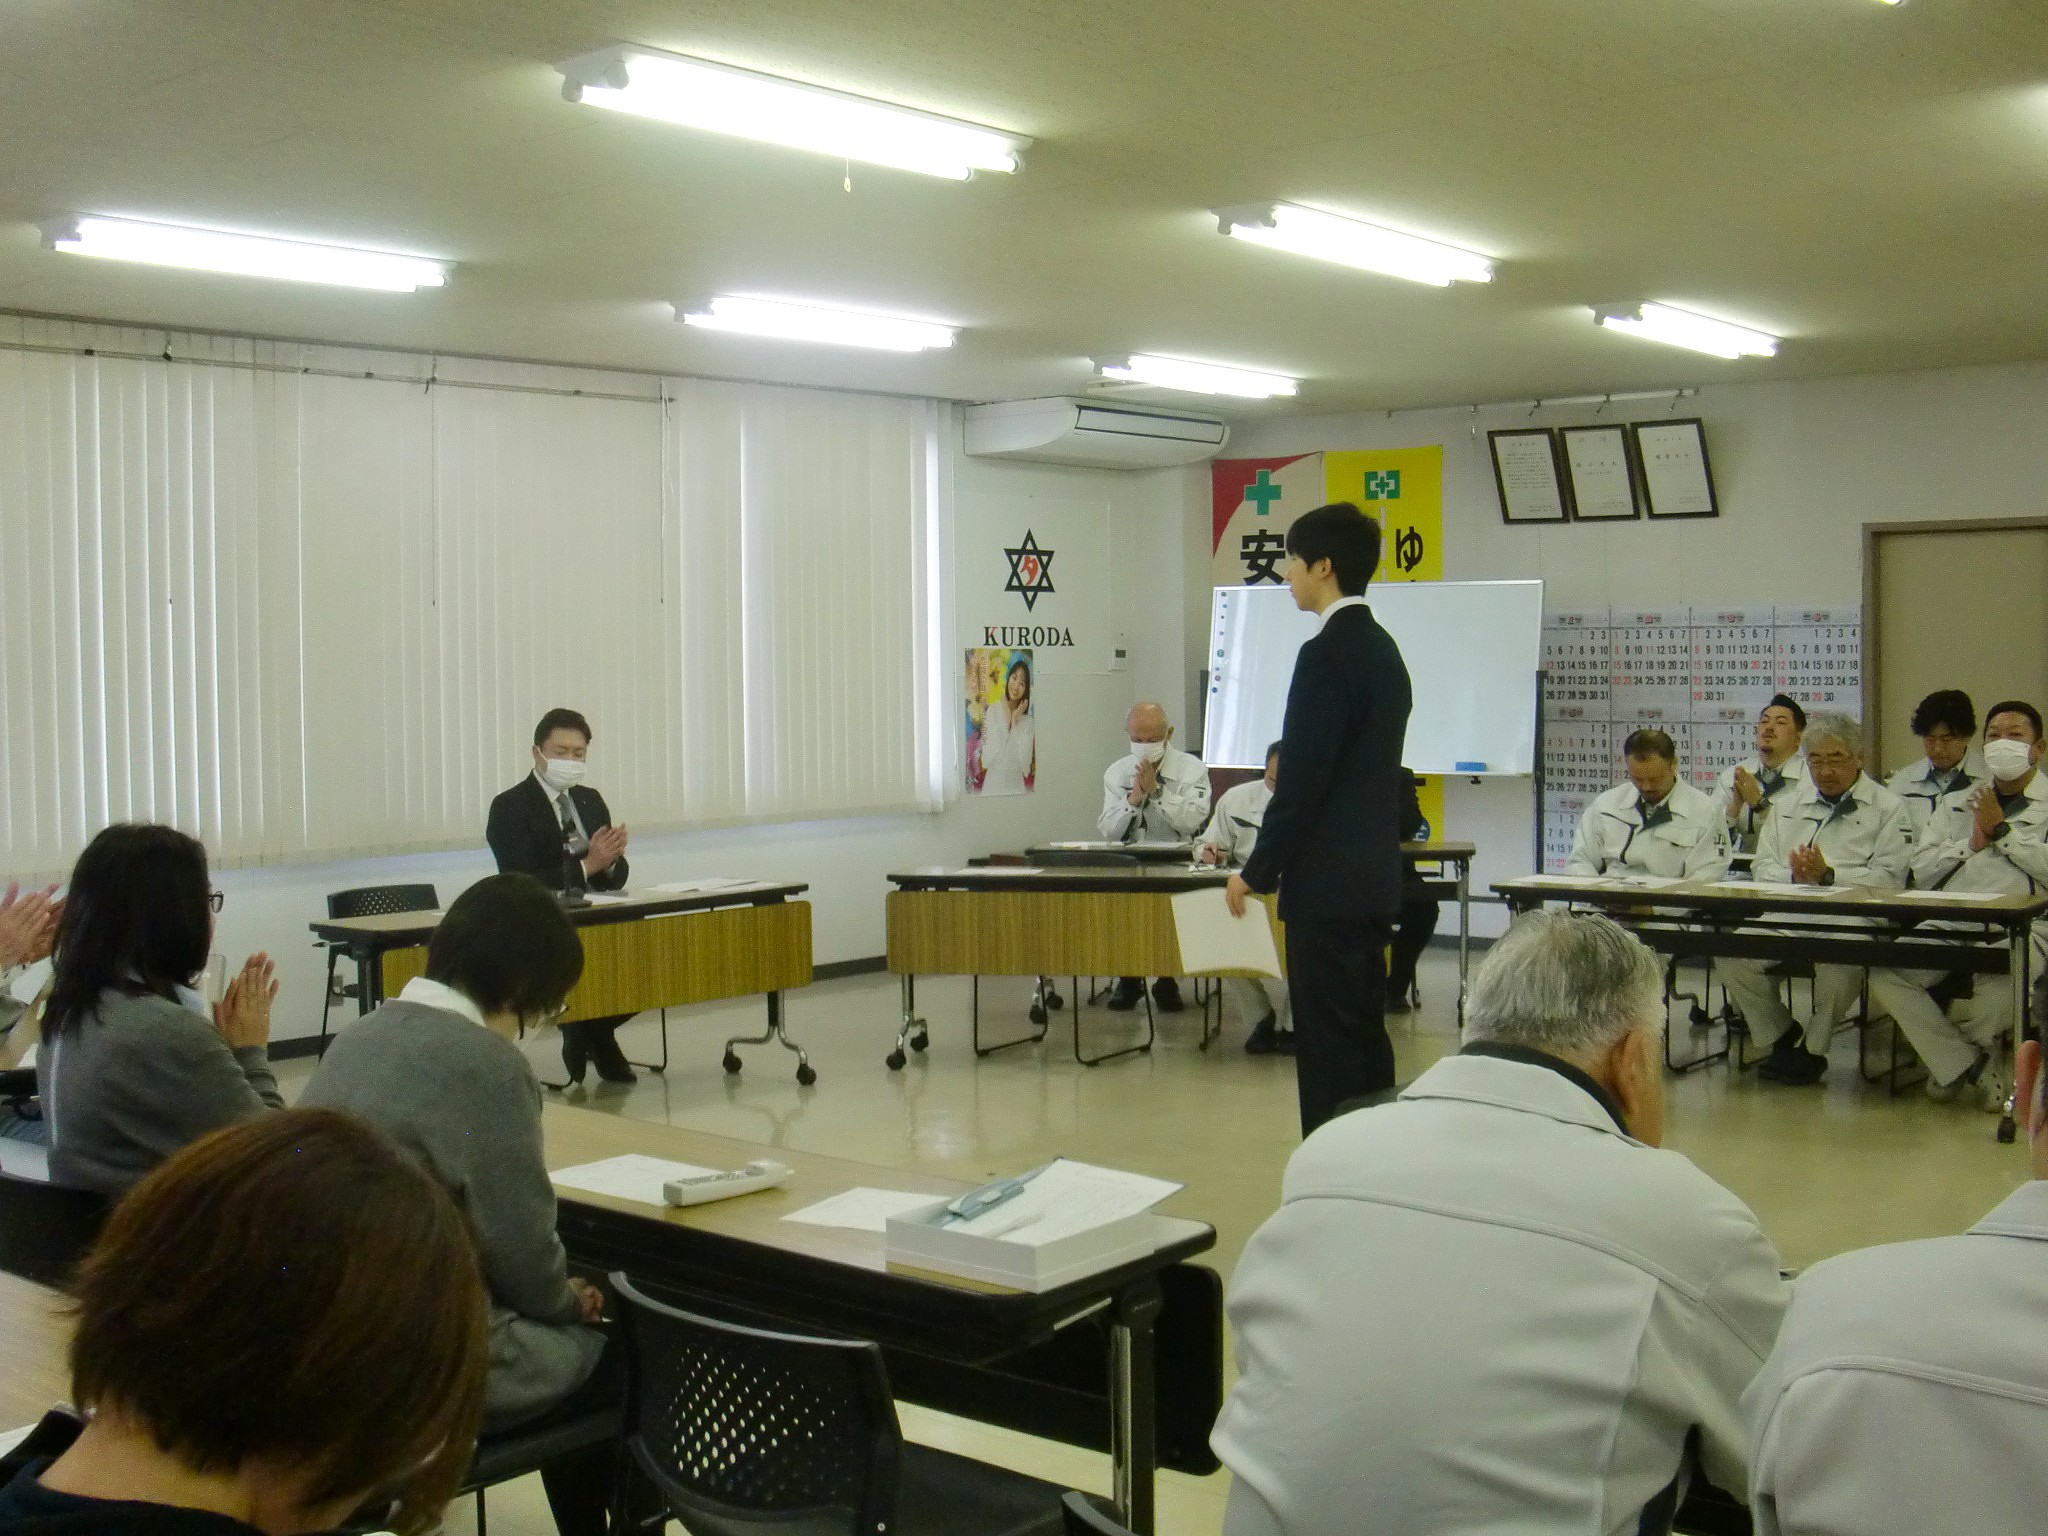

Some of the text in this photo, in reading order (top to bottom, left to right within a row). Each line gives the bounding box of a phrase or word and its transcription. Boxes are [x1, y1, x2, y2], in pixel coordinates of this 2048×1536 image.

[1240, 529, 1286, 586] 安
[1395, 526, 1424, 582] ゆ
[983, 626, 1075, 647] KURODA
[1590, 630, 1595, 640] 2
[1601, 630, 1606, 640] 3
[1624, 630, 1630, 640] 2
[1635, 629, 1641, 640] 3
[1647, 630, 1652, 639] 4
[1658, 629, 1663, 640] 5
[1669, 629, 1675, 639] 6
[1680, 629, 1686, 639] 7
[1705, 629, 1710, 639] 2
[1716, 629, 1722, 639] 3
[1728, 629, 1734, 639] 4
[1740, 628, 1746, 639] 5
[1752, 628, 1758, 639] 6
[1764, 628, 1770, 639] 7
[1826, 628, 1831, 638] 2
[1838, 628, 1844, 638] 3
[1851, 628, 1856, 638] 4
[1547, 645, 1609, 656] 5 6 7 8 9 10
[1625, 645, 1688, 655] 9 10 12 13 14
[1705, 644, 1772, 655] 9 10 11 12 13 14
[1790, 644, 1796, 655] 6
[1802, 644, 1808, 654] 7
[1814, 644, 1820, 654] 8
[1826, 644, 1832, 654] 9
[1836, 644, 1846, 654] 10
[1849, 644, 1858, 654] 11
[1556, 660, 1609, 671] 13 14 15 16 17
[1624, 660, 1632, 670] 16
[1633, 660, 1643, 670] 17
[1645, 660, 1654, 670] 18
[1656, 660, 1666, 670] 19
[1667, 660, 1677, 670] 20
[1679, 660, 1689, 670] 21
[1704, 660, 1713, 670] 16
[1715, 660, 1724, 670] 17
[1727, 660, 1736, 670] 18
[1739, 660, 1749, 670] 19
[1762, 660, 1772, 670] 21
[1788, 660, 1798, 670] 13
[1800, 660, 1810, 670] 14
[1812, 660, 1822, 670] 15
[1824, 660, 1834, 670] 16
[1836, 660, 1846, 670] 17
[1848, 660, 1859, 670] 18
[1556, 675, 1566, 685] 20
[1567, 675, 1576, 685] 21
[1577, 675, 1587, 685] 22
[1589, 675, 1598, 685] 23
[1599, 675, 1609, 685] 24
[1633, 675, 1689, 686] 24 25 26 27 28
[1704, 675, 1772, 686] 23 24 25 26 27 28
[1788, 676, 1859, 686] 20 21 22 23 24 25
[1545, 690, 1609, 700] 26 27 28 29 30 31
[1704, 691, 1725, 702] 30 31
[1800, 692, 1810, 702] 28
[1824, 692, 1834, 702] 30
